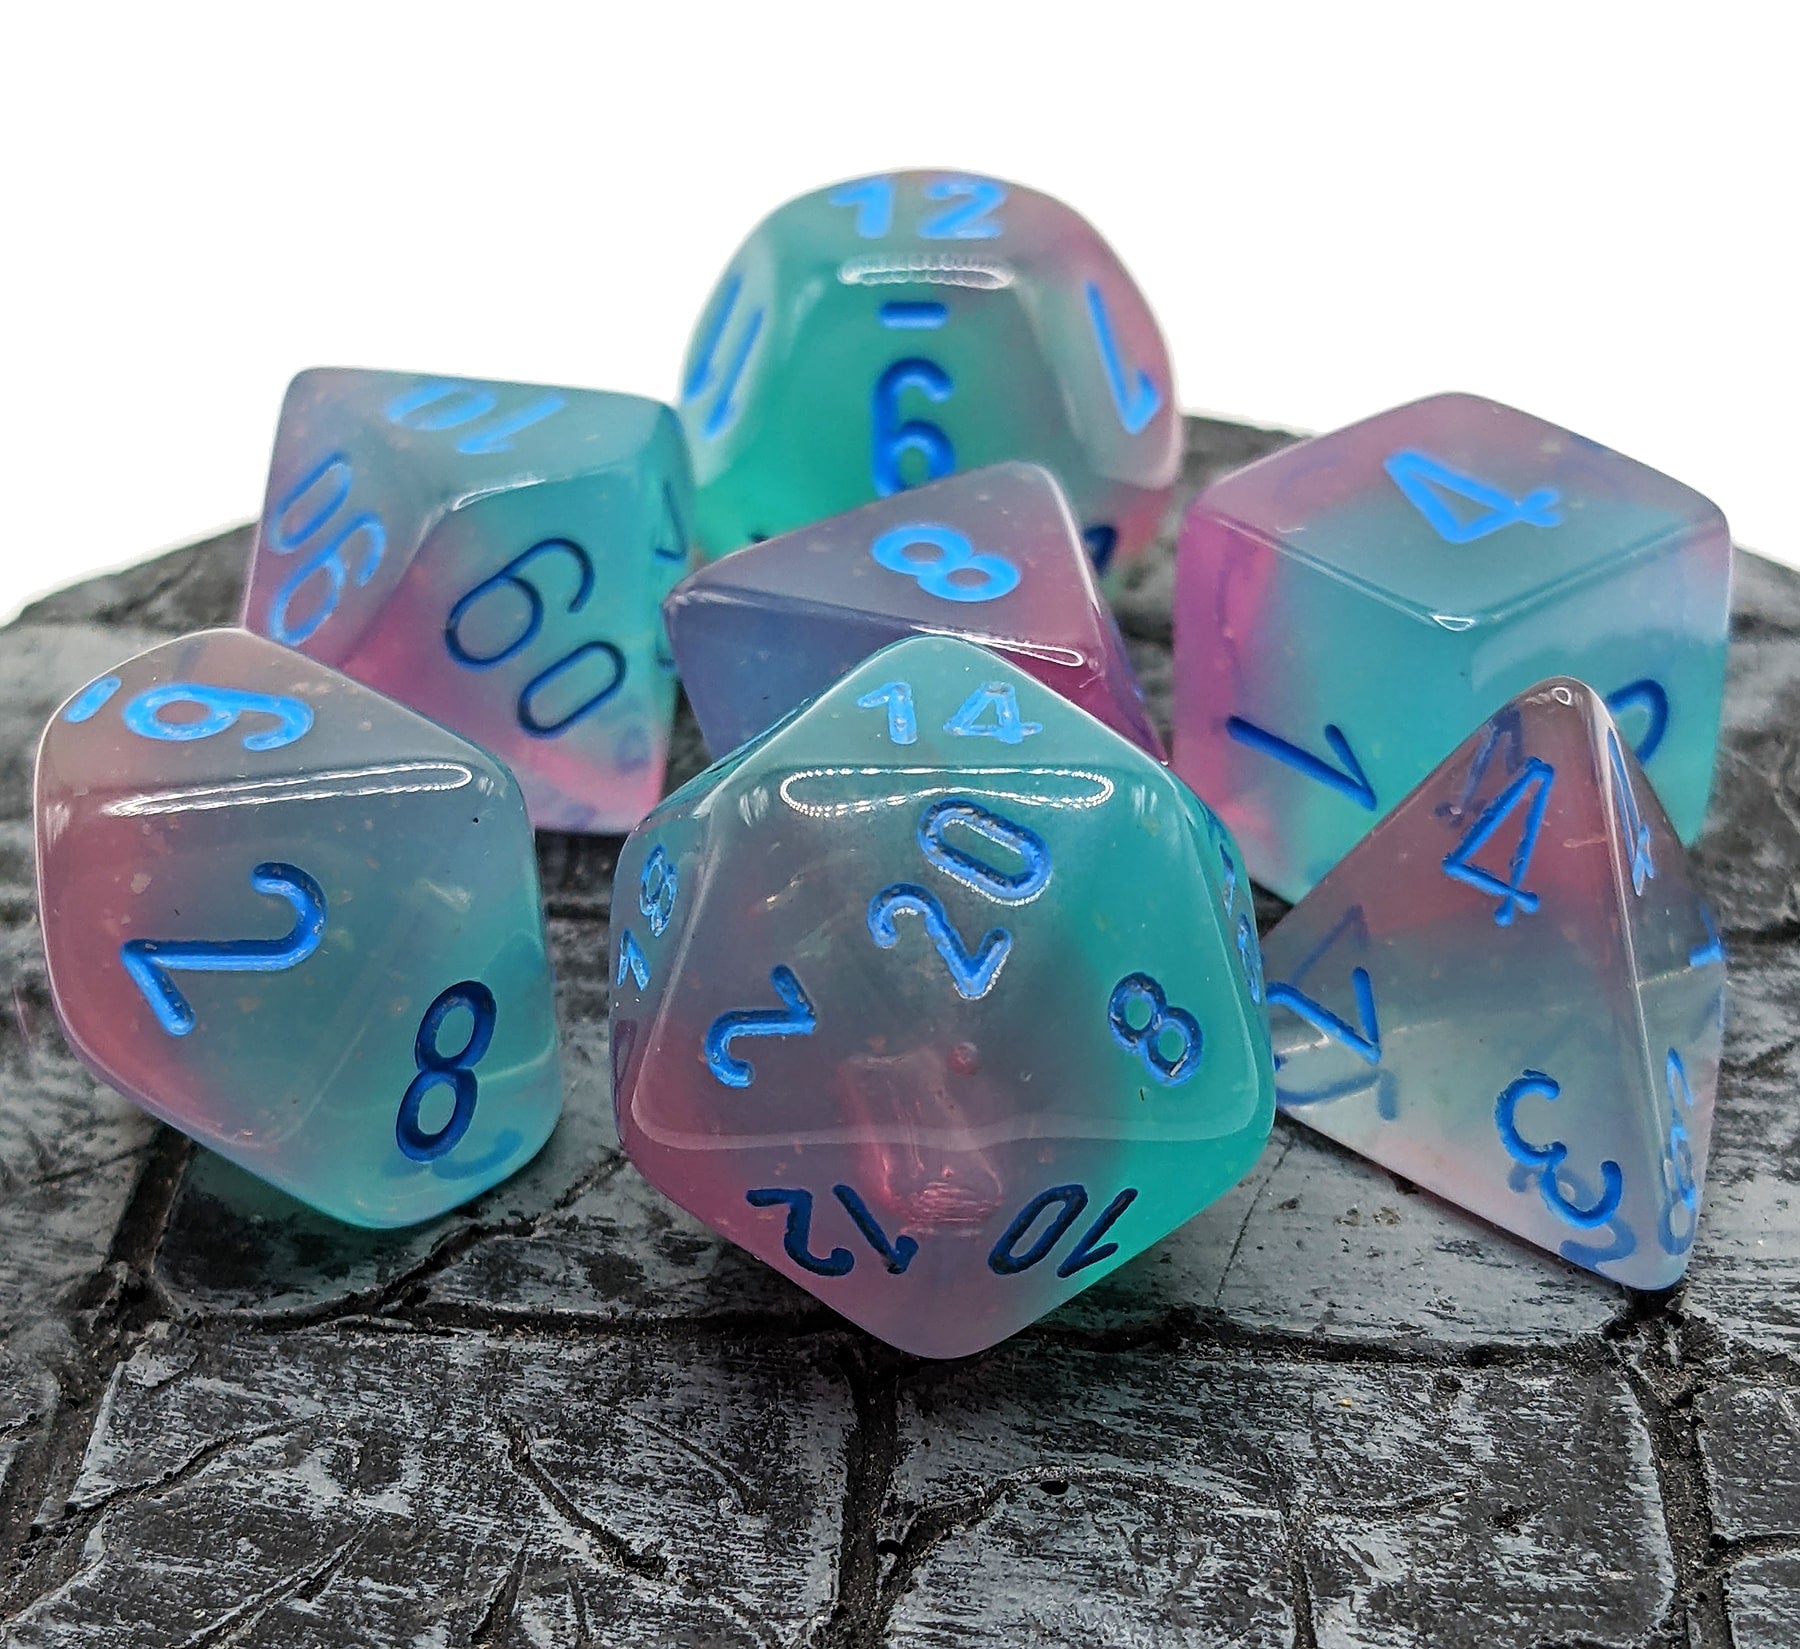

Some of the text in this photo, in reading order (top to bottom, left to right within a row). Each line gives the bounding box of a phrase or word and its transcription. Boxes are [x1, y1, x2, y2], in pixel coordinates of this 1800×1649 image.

[828, 178, 1006, 239] 12
[1383, 448, 1563, 544] 4
[870, 522, 1021, 602] 8
[857, 681, 1043, 745] 14
[1441, 756, 1554, 928] 4
[867, 800, 1051, 1000] 20
[396, 979, 498, 1164] 8
[1109, 971, 1203, 1087] 8
[1494, 1070, 1622, 1230] 3
[746, 1184, 919, 1276] 12
[988, 1184, 1139, 1279] 10
